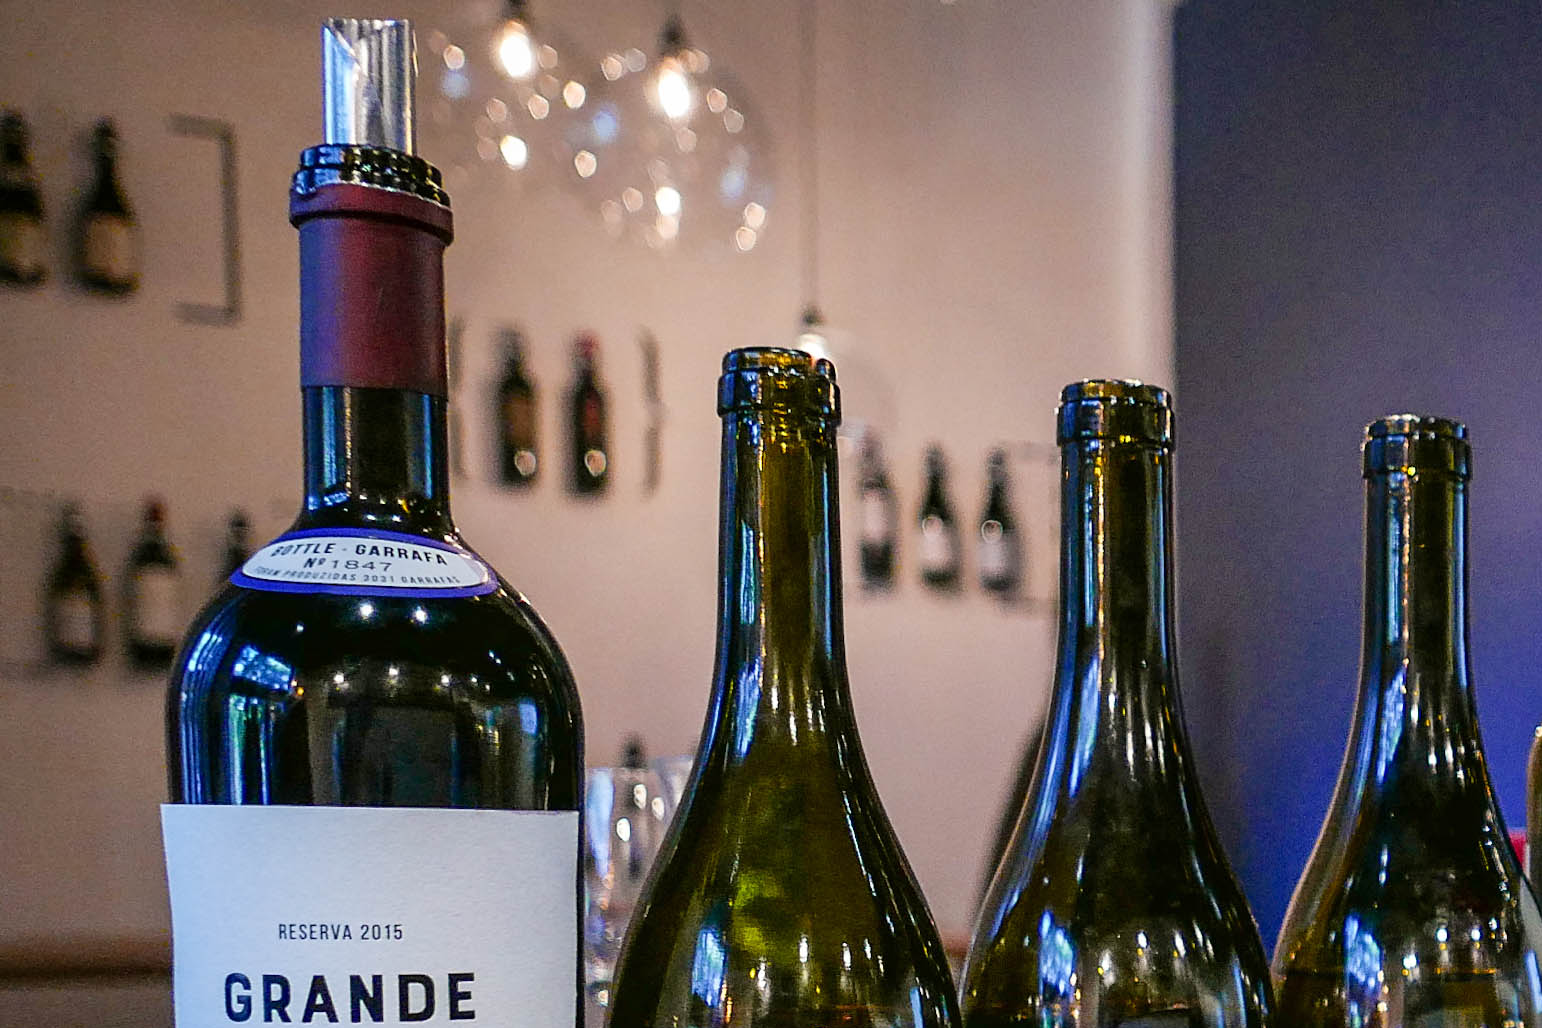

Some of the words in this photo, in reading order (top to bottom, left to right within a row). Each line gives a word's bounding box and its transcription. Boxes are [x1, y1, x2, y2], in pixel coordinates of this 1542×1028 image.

[271, 543, 337, 557] BOTTLE
[355, 543, 448, 566] GARRAFA
[332, 560, 392, 572] 1847
[282, 570, 356, 581] PRODUZIDAS
[278, 924, 353, 940] RESERVA
[361, 924, 403, 940] 2015
[225, 972, 476, 1023] GRANDE
